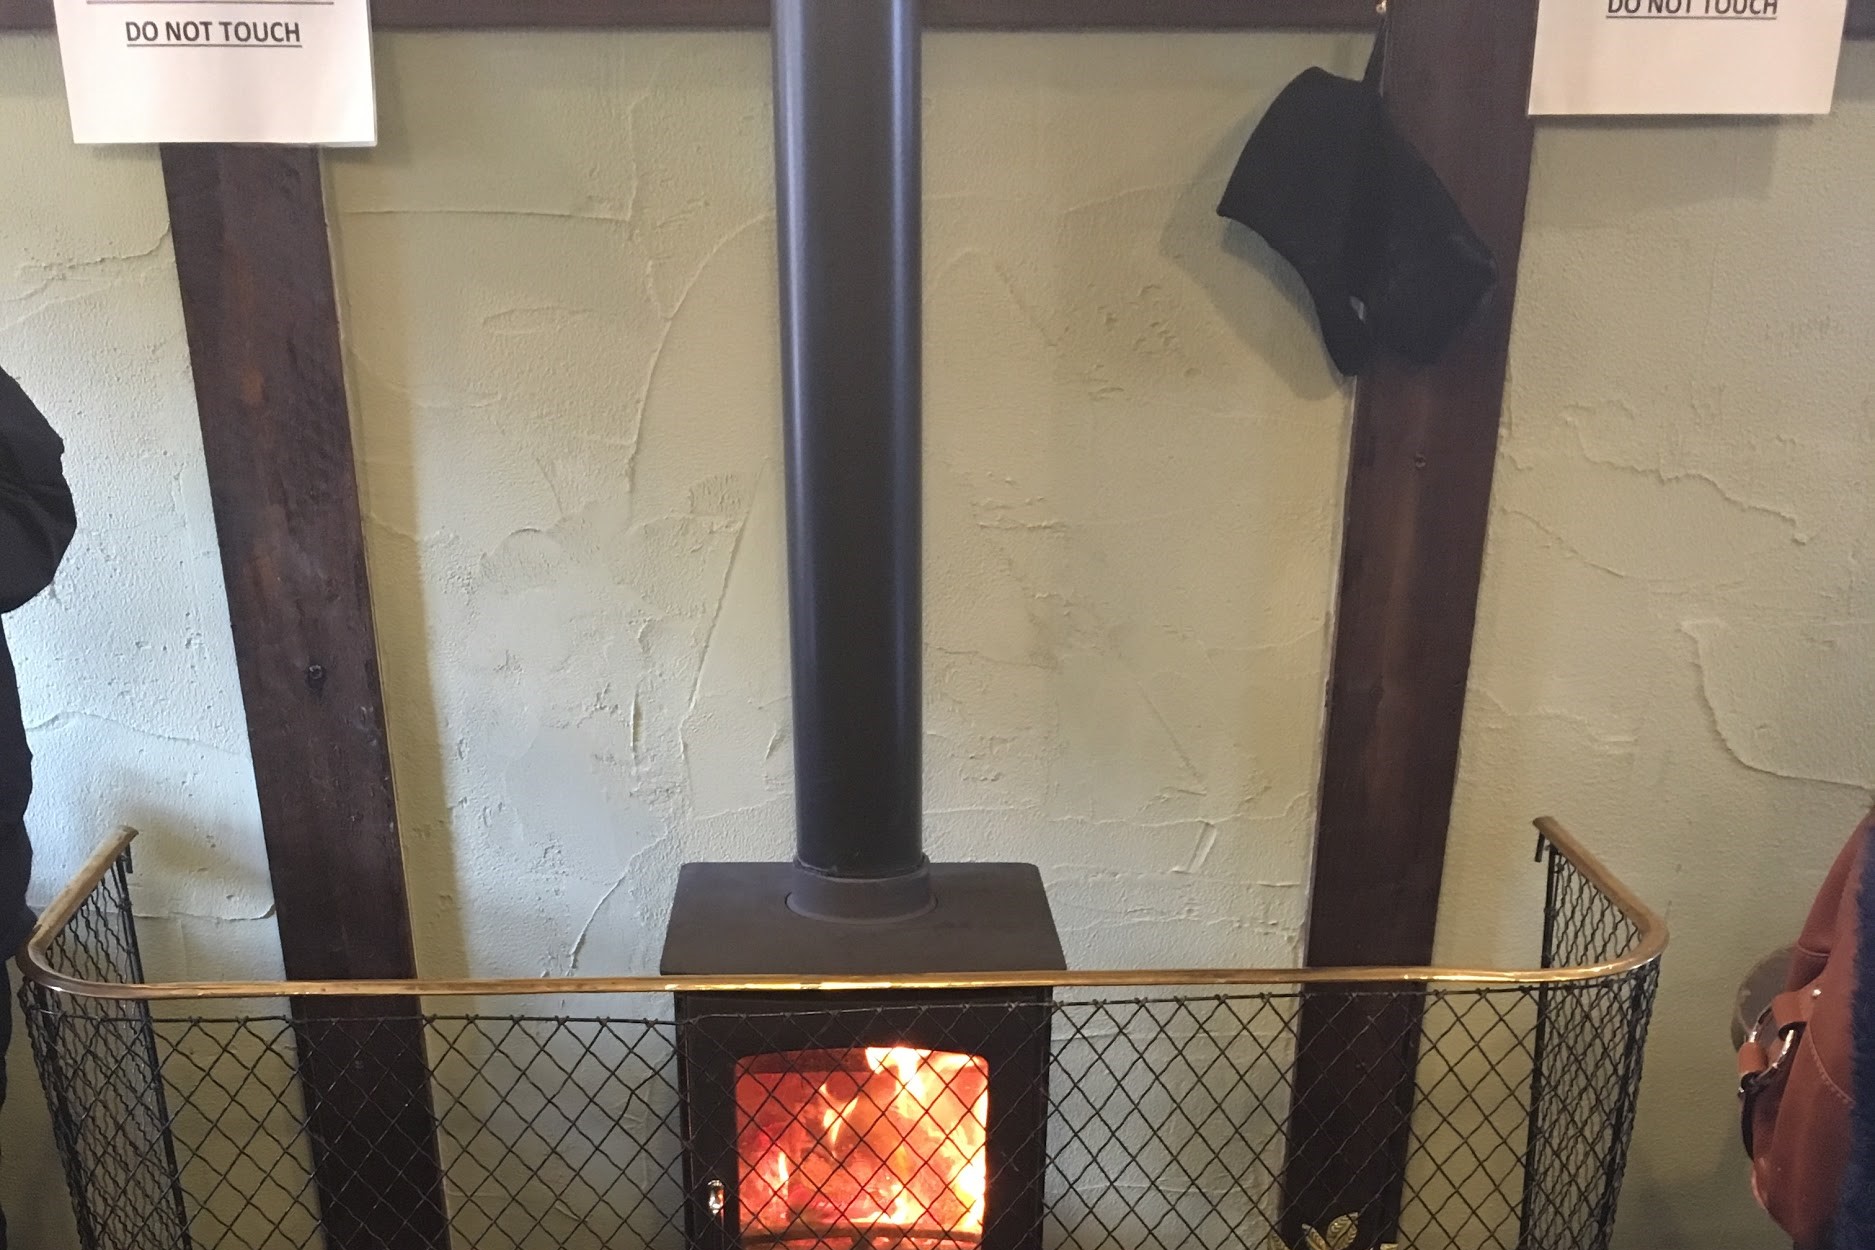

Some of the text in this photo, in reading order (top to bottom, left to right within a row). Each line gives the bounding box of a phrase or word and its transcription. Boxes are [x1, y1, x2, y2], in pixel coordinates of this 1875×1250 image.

[1608, 0, 1641, 13] DO
[125, 21, 301, 42] DO NOT TOUCH
